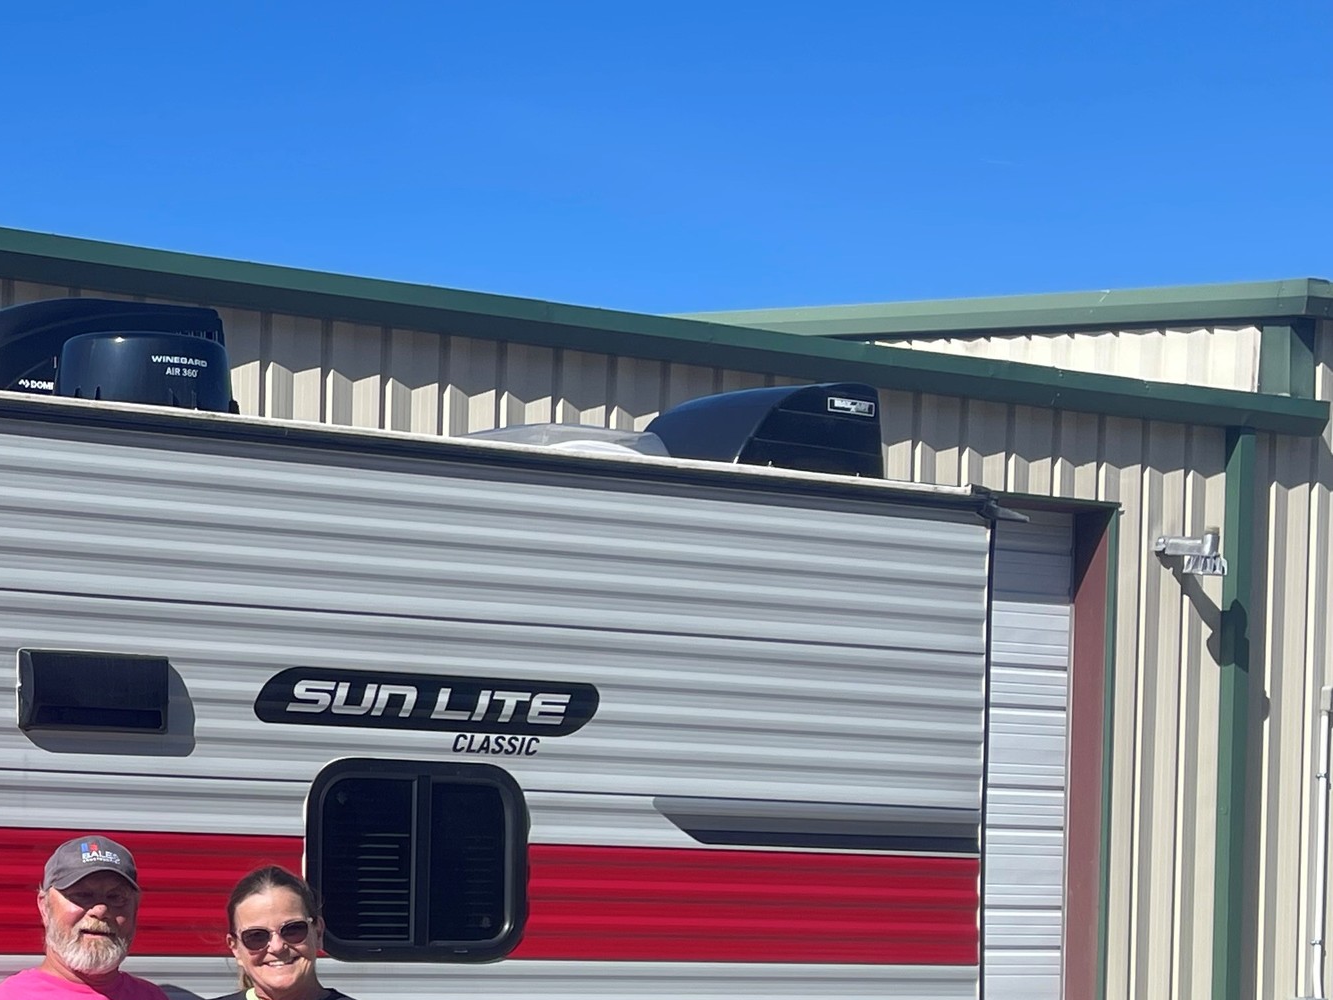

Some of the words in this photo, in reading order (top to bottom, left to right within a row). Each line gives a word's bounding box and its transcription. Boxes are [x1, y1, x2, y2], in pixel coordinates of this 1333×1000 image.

[151, 355, 208, 367] WINEGARD
[165, 366, 181, 376] AIR
[286, 678, 418, 718] SUN
[430, 687, 572, 725] LITE
[452, 733, 541, 756] CLASSIC
